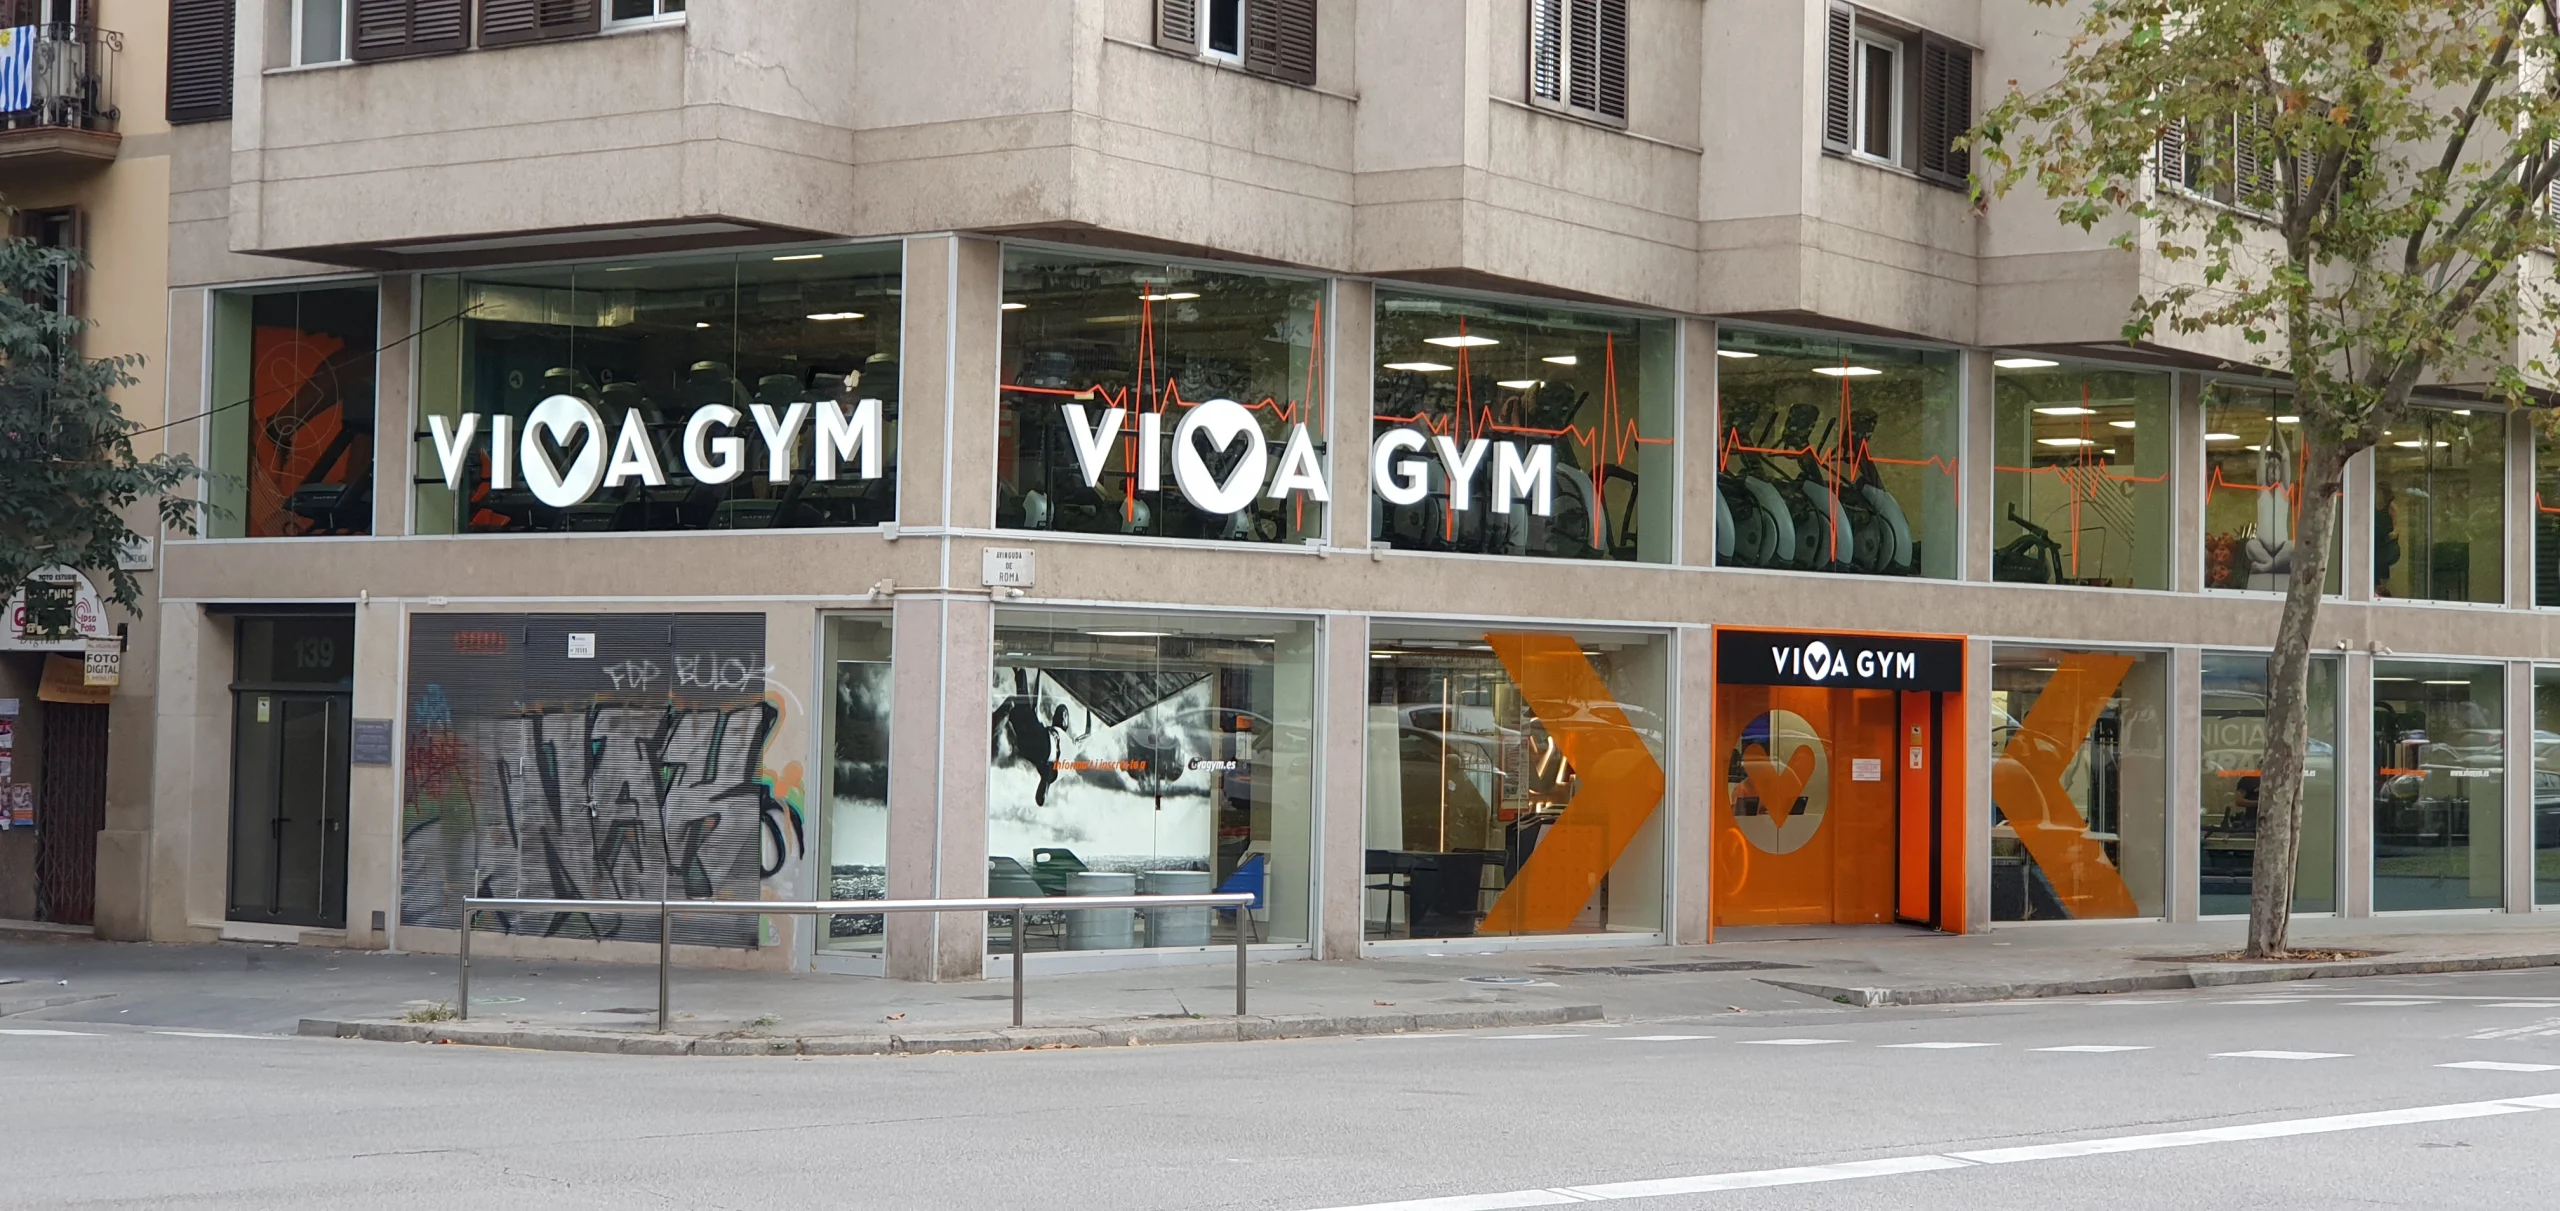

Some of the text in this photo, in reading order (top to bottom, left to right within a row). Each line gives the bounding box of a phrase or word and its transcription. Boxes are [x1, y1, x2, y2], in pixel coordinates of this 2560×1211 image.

[683, 398, 882, 485] GYM
[1372, 428, 1553, 517] GYM
[996, 551, 1023, 559] AVINGUDA
[1005, 562, 1013, 570] DE
[999, 572, 1020, 582] ROMA
[295, 637, 334, 668] 139
[86, 653, 119, 663] FOTO
[86, 664, 119, 674] DIGITAL
[1856, 649, 1916, 680] GYM
